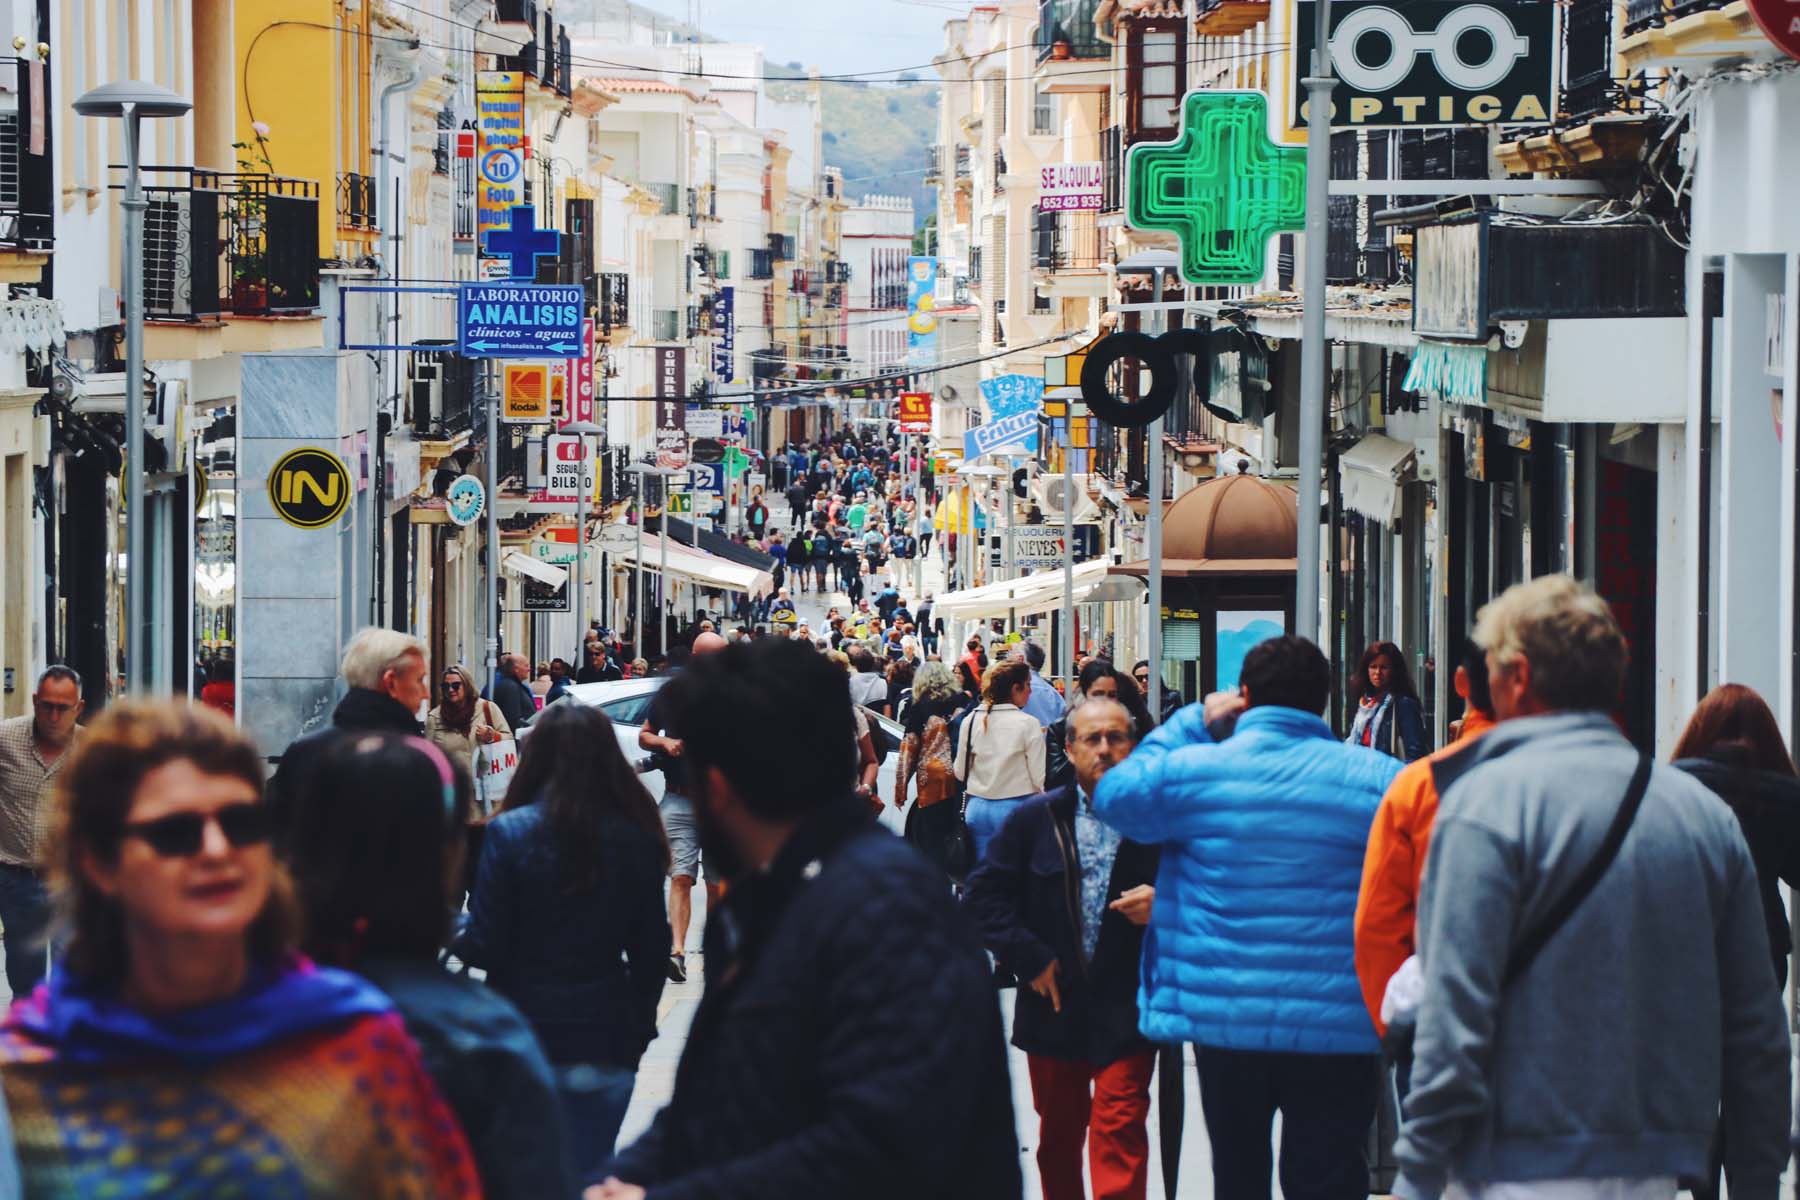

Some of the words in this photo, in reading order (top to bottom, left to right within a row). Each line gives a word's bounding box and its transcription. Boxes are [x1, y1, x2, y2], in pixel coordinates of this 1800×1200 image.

[486, 134, 519, 146] photo
[492, 162, 510, 177] 10
[1041, 168, 1055, 189] SE
[1059, 166, 1101, 188] ALQUILA
[487, 187, 515, 203] Foto
[1042, 197, 1062, 209] 652
[1081, 195, 1102, 208] 935
[467, 288, 580, 303] LABORATORIO
[467, 304, 578, 326] ANALISIS
[468, 326, 522, 338] clínicos
[535, 330, 577, 342] aguas
[510, 402, 540, 412] Kodak
[556, 464, 587, 474] SEGUR
[281, 470, 339, 507] IN
[552, 477, 592, 488] BILBO
[1016, 540, 1057, 556] NIEVES
[526, 598, 566, 608] Charanga
